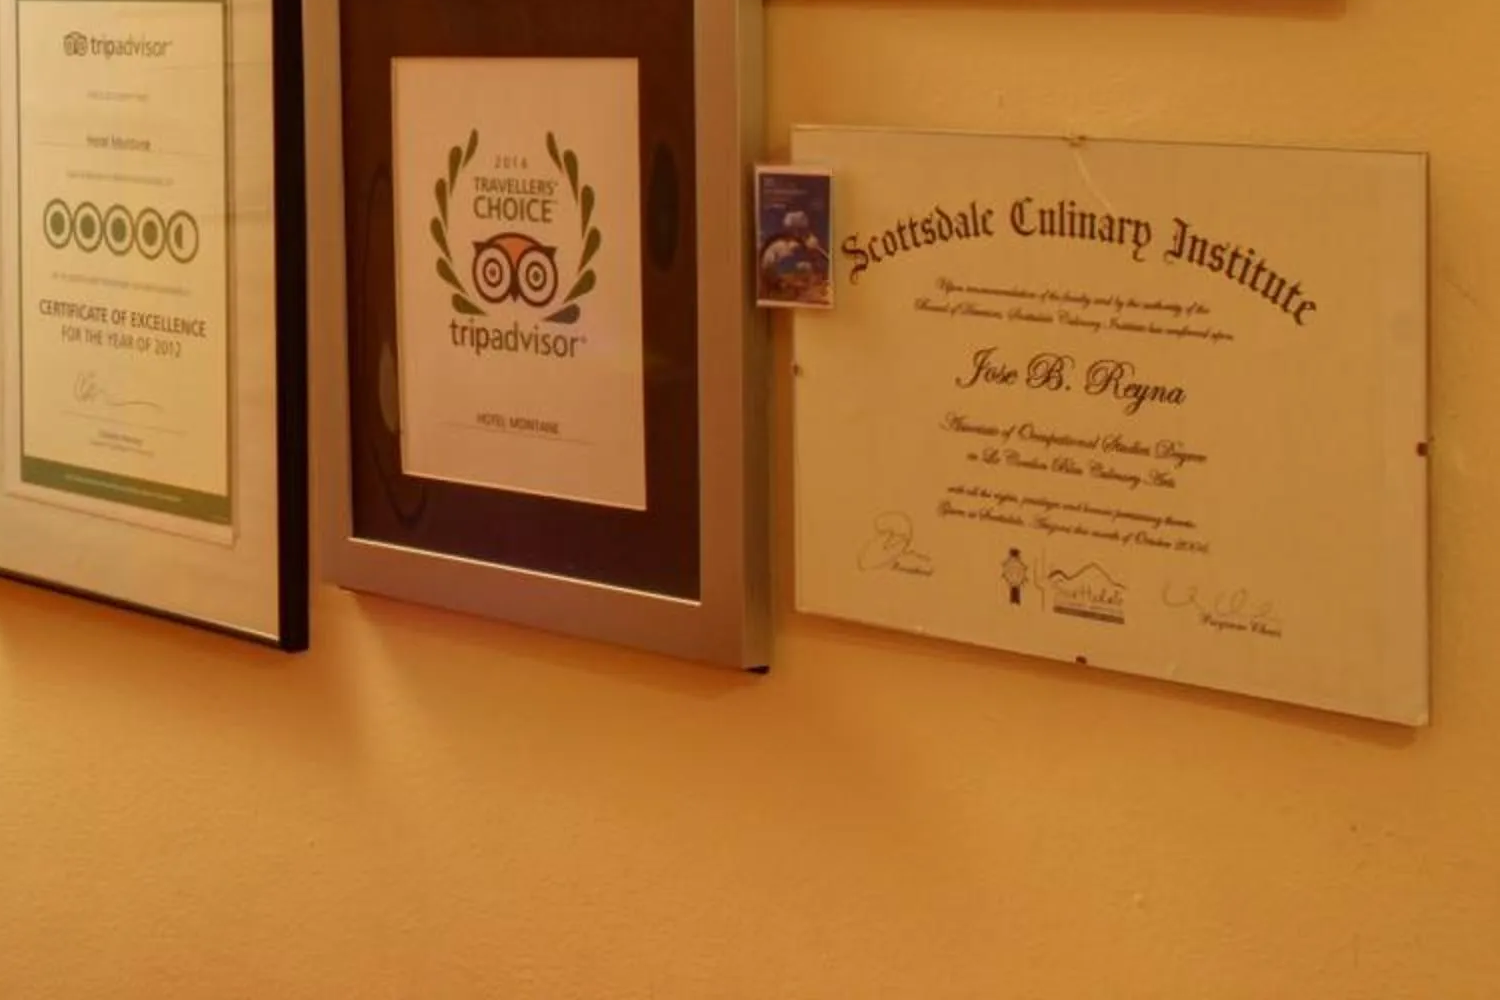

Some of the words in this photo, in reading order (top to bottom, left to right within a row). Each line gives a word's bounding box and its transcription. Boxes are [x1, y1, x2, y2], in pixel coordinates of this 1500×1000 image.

[91, 34, 169, 60] tripadvisor
[473, 198, 554, 223] CHOICE
[841, 200, 996, 285] Scottsdale
[1009, 197, 1153, 263] Culinary
[1163, 217, 1318, 327] Institute
[39, 298, 108, 323] CERTIFICATE
[111, 308, 128, 328] OF
[131, 311, 207, 338] EXCELLENCE
[449, 317, 581, 358] tripadvisor
[61, 325, 82, 344] FOR
[85, 328, 103, 347] THE
[107, 330, 134, 350] YEAR
[137, 335, 151, 353] OF
[154, 339, 182, 359] 2012
[955, 346, 1019, 389] Jose
[1025, 352, 1076, 392] B.
[1084, 359, 1188, 417] Reyna
